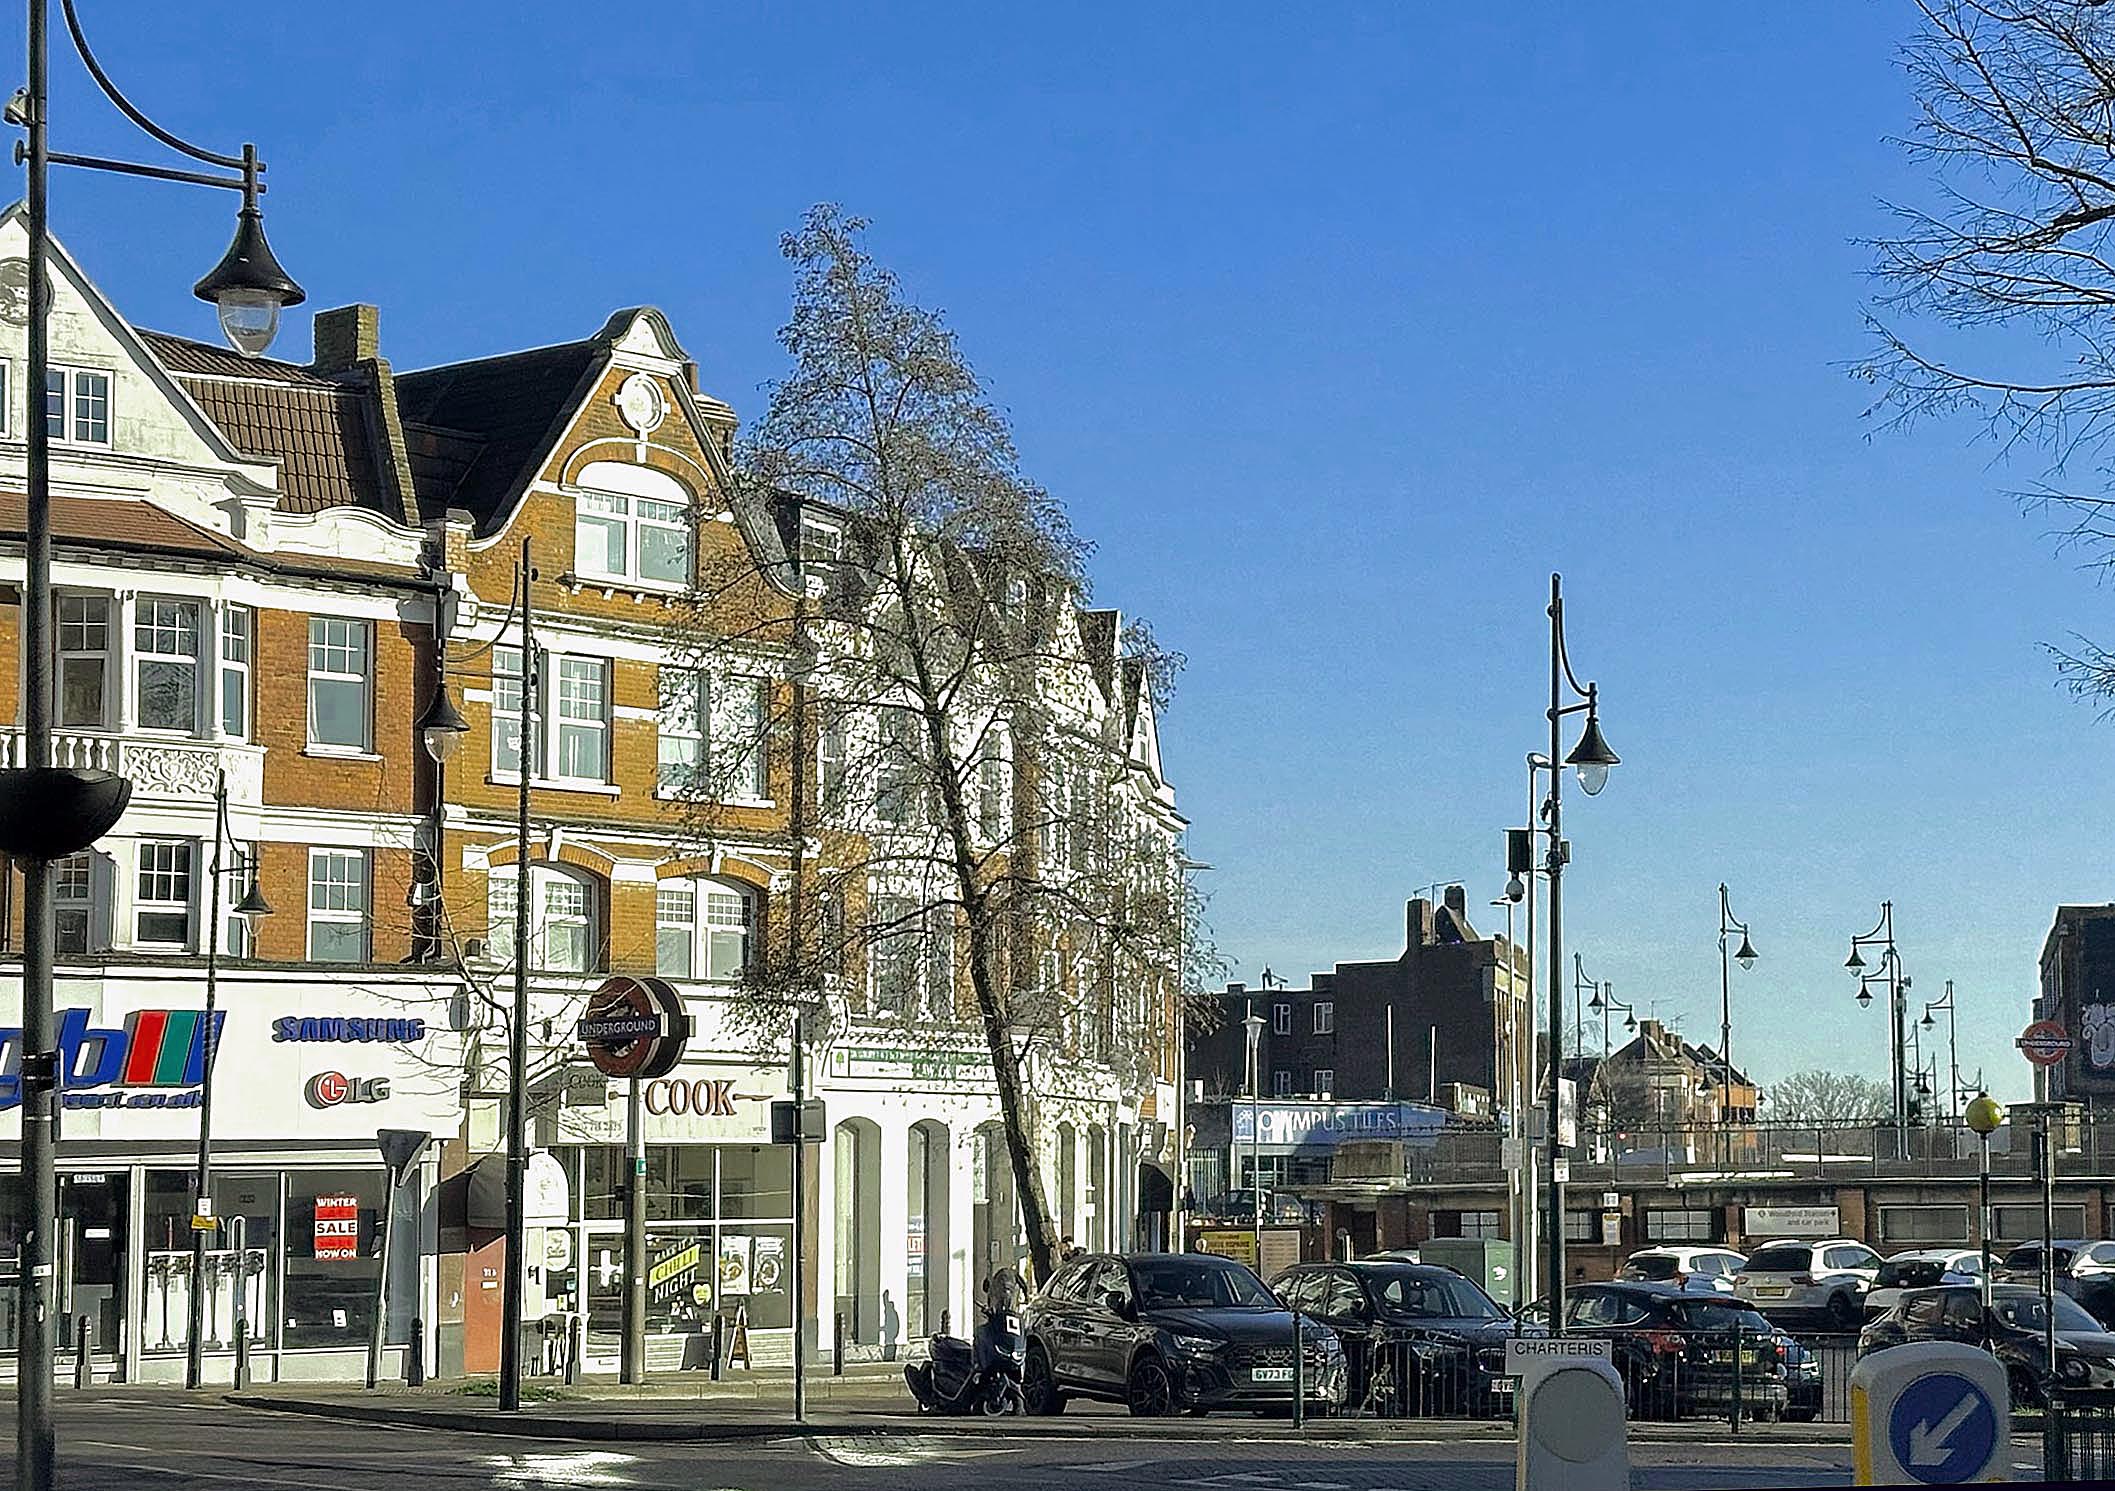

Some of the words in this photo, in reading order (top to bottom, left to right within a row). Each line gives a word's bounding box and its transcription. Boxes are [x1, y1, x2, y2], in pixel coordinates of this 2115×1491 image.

[272, 1016, 425, 1043] SAMSUNG
[580, 1018, 656, 1035] UNDERGROUND
[645, 1078, 738, 1117] COOK
[316, 1197, 358, 1208] WINTER
[316, 1222, 357, 1234] SALE
[314, 1248, 340, 1259] NOW
[340, 1248, 357, 1259] ON
[656, 1250, 693, 1281] CHILLI
[654, 1266, 698, 1304] NIGHT
[1514, 1342, 1603, 1356] CHARTERIS
